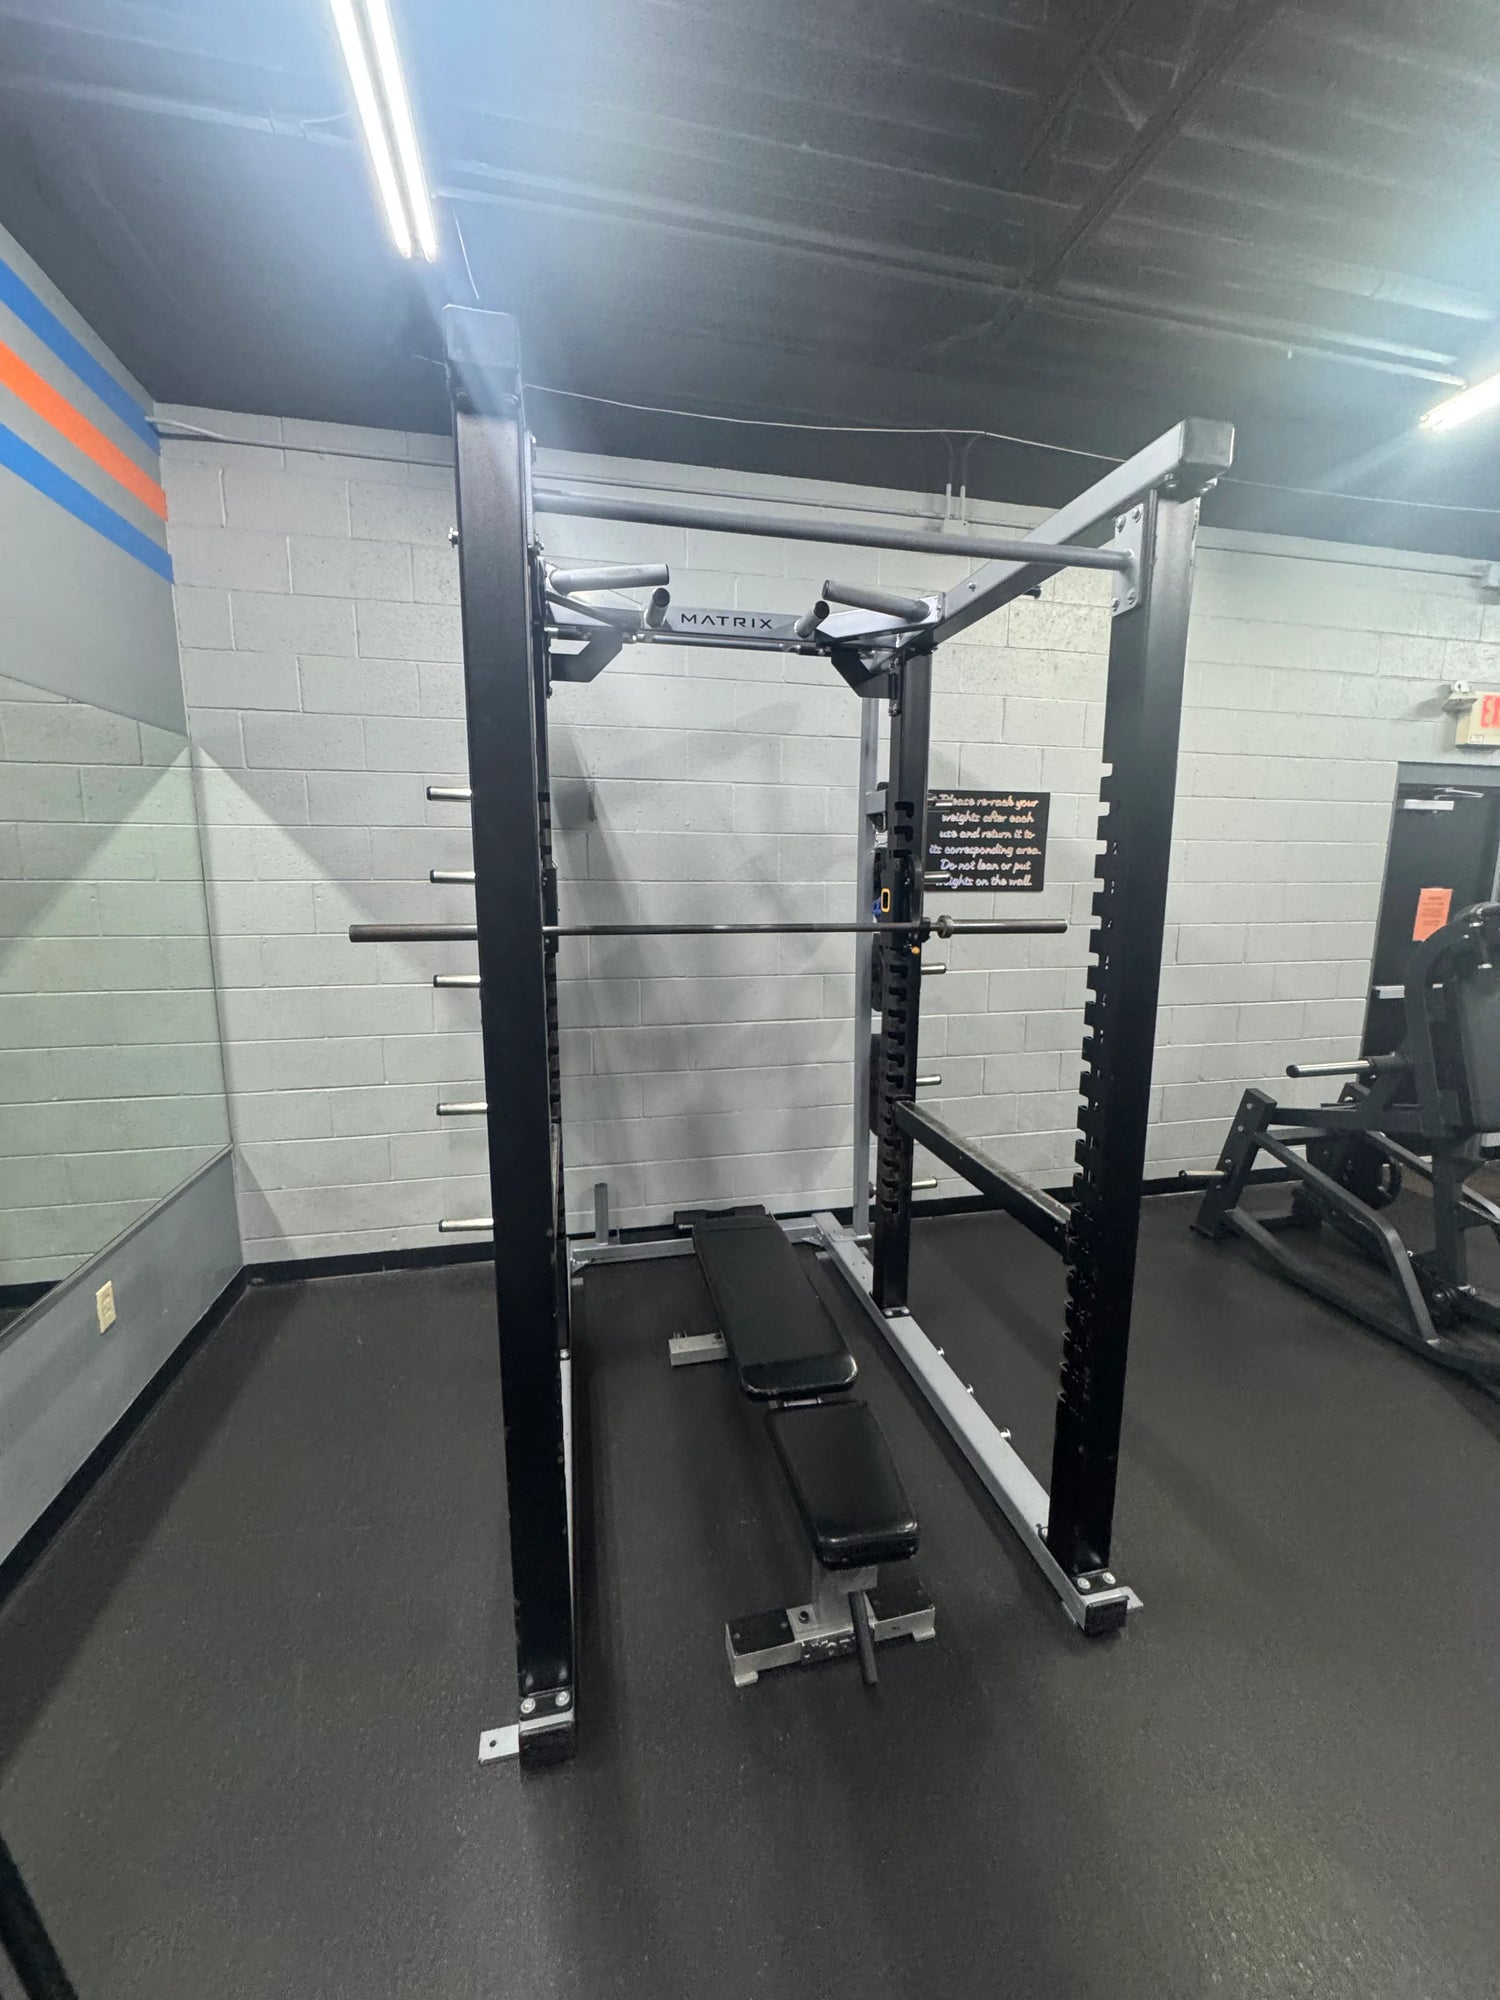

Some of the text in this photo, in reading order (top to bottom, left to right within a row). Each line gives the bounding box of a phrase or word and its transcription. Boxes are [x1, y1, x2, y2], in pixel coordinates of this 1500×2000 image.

[681, 613, 773, 630] MATRIX
[1015, 799, 1039, 811] your
[941, 810, 1035, 826] weights after each
[939, 827, 1036, 839] use and return it to
[929, 843, 1042, 858] its corresponding area.
[940, 858, 1032, 874] Do not lean or put
[935, 874, 1033, 889] ights on the wall.
